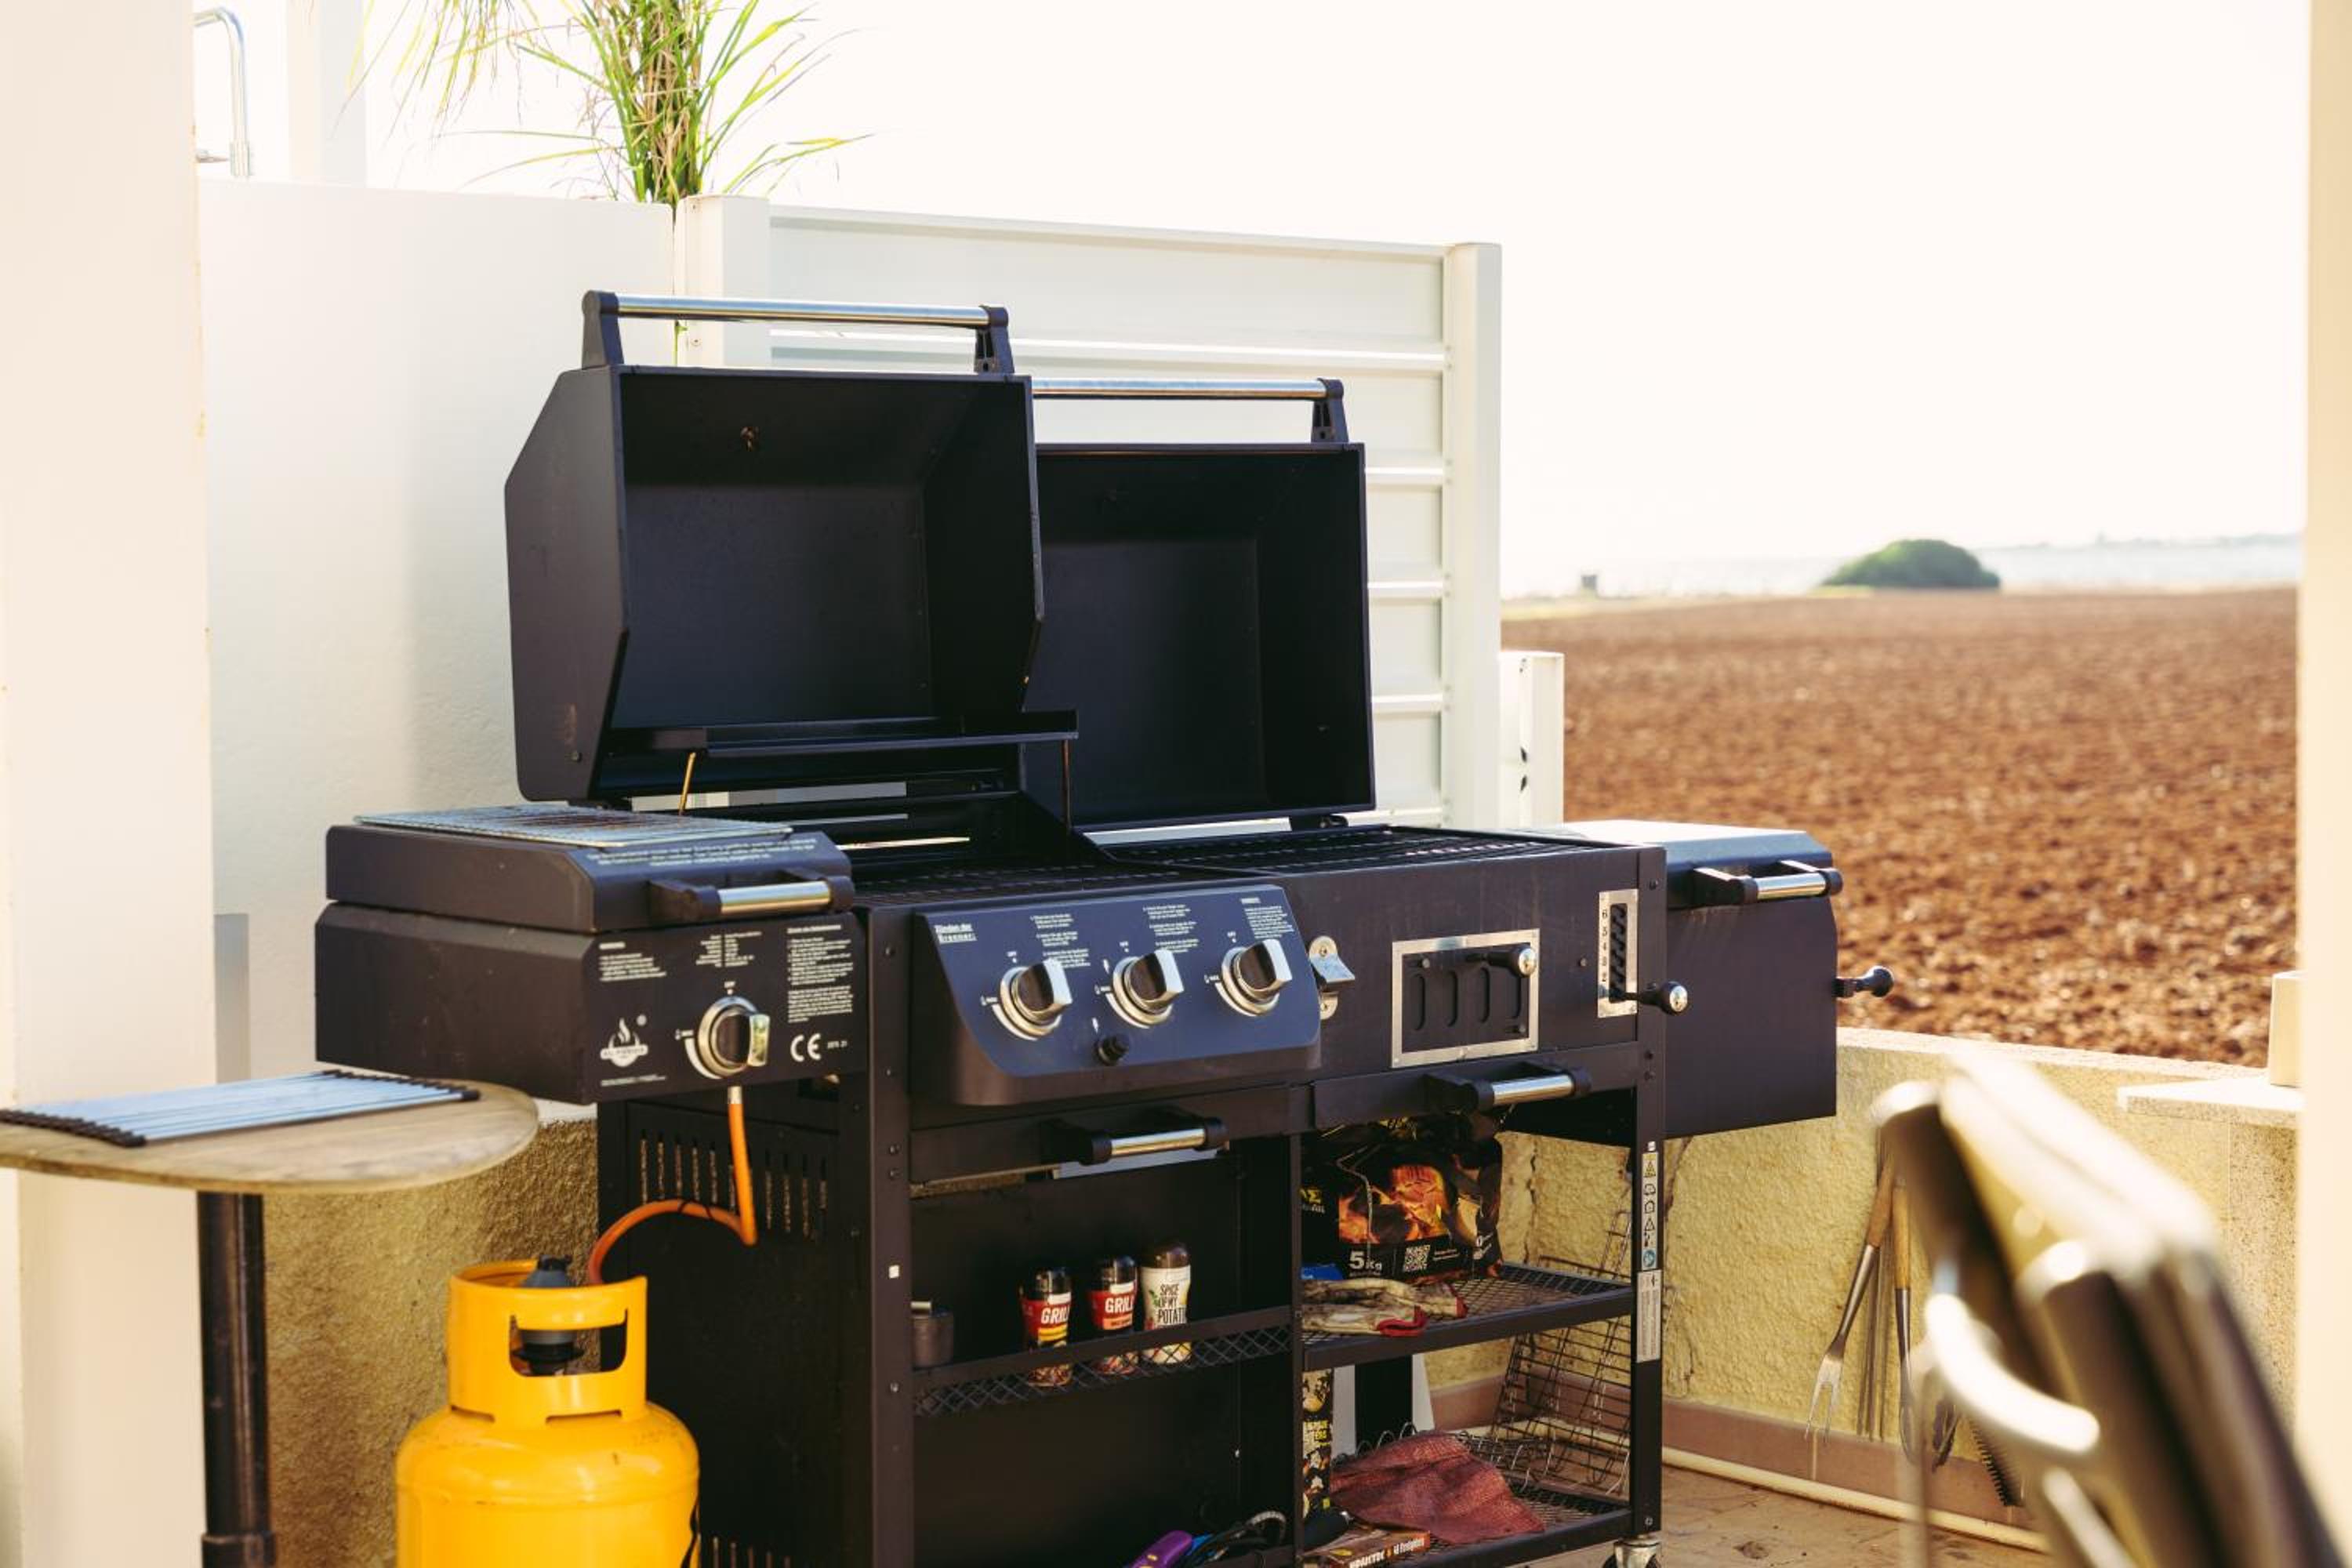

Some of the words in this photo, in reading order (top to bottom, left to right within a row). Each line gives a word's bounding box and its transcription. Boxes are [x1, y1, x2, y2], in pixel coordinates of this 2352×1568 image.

[1602, 909, 1608, 920] 6
[790, 1033, 822, 1062] CE
[1349, 1250, 1364, 1269] 5
[1160, 1283, 1179, 1295] SPICE
